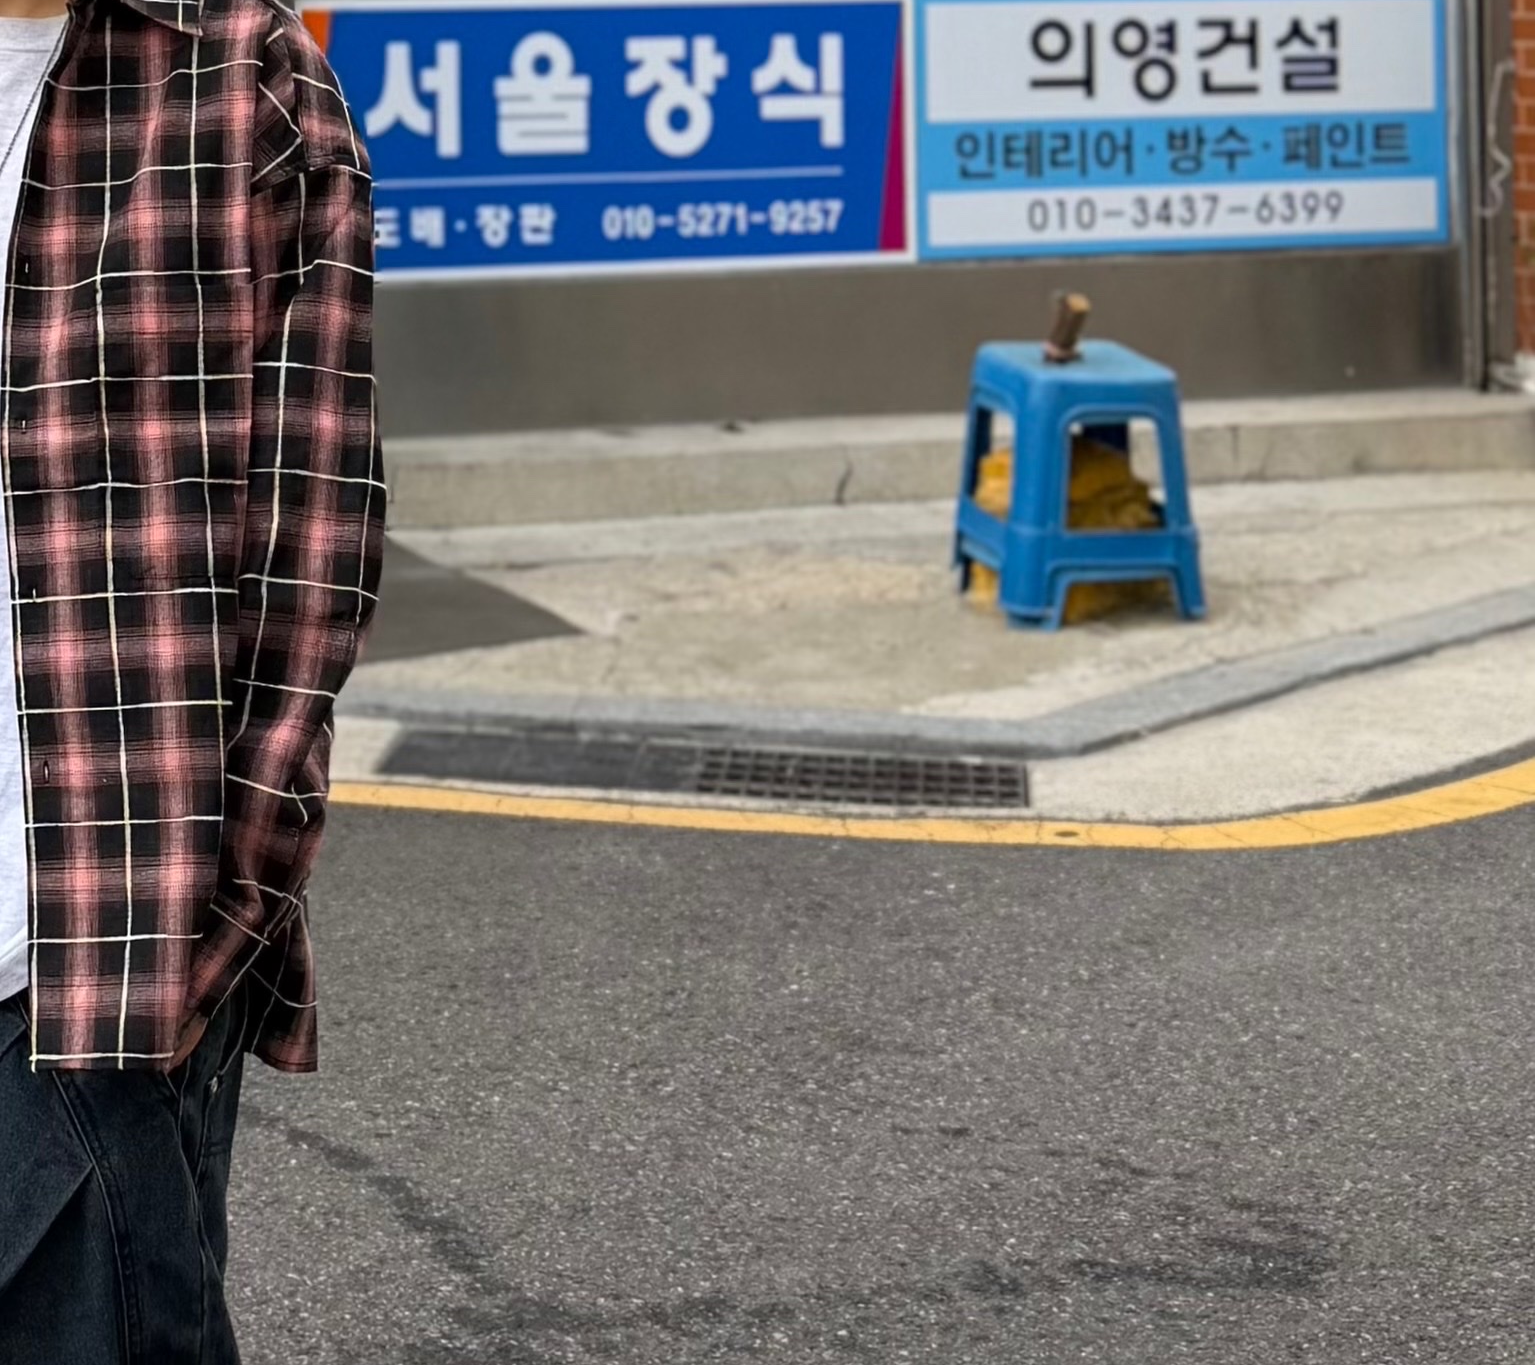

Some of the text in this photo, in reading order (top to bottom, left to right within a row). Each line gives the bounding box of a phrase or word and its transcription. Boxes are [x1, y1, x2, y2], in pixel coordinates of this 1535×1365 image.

[1028, 16, 1341, 103] 의영건설
[366, 32, 844, 159] 서울장식
[602, 199, 843, 240] 010-5271-9257
[1027, 191, 1345, 233] 010-3437-6399
